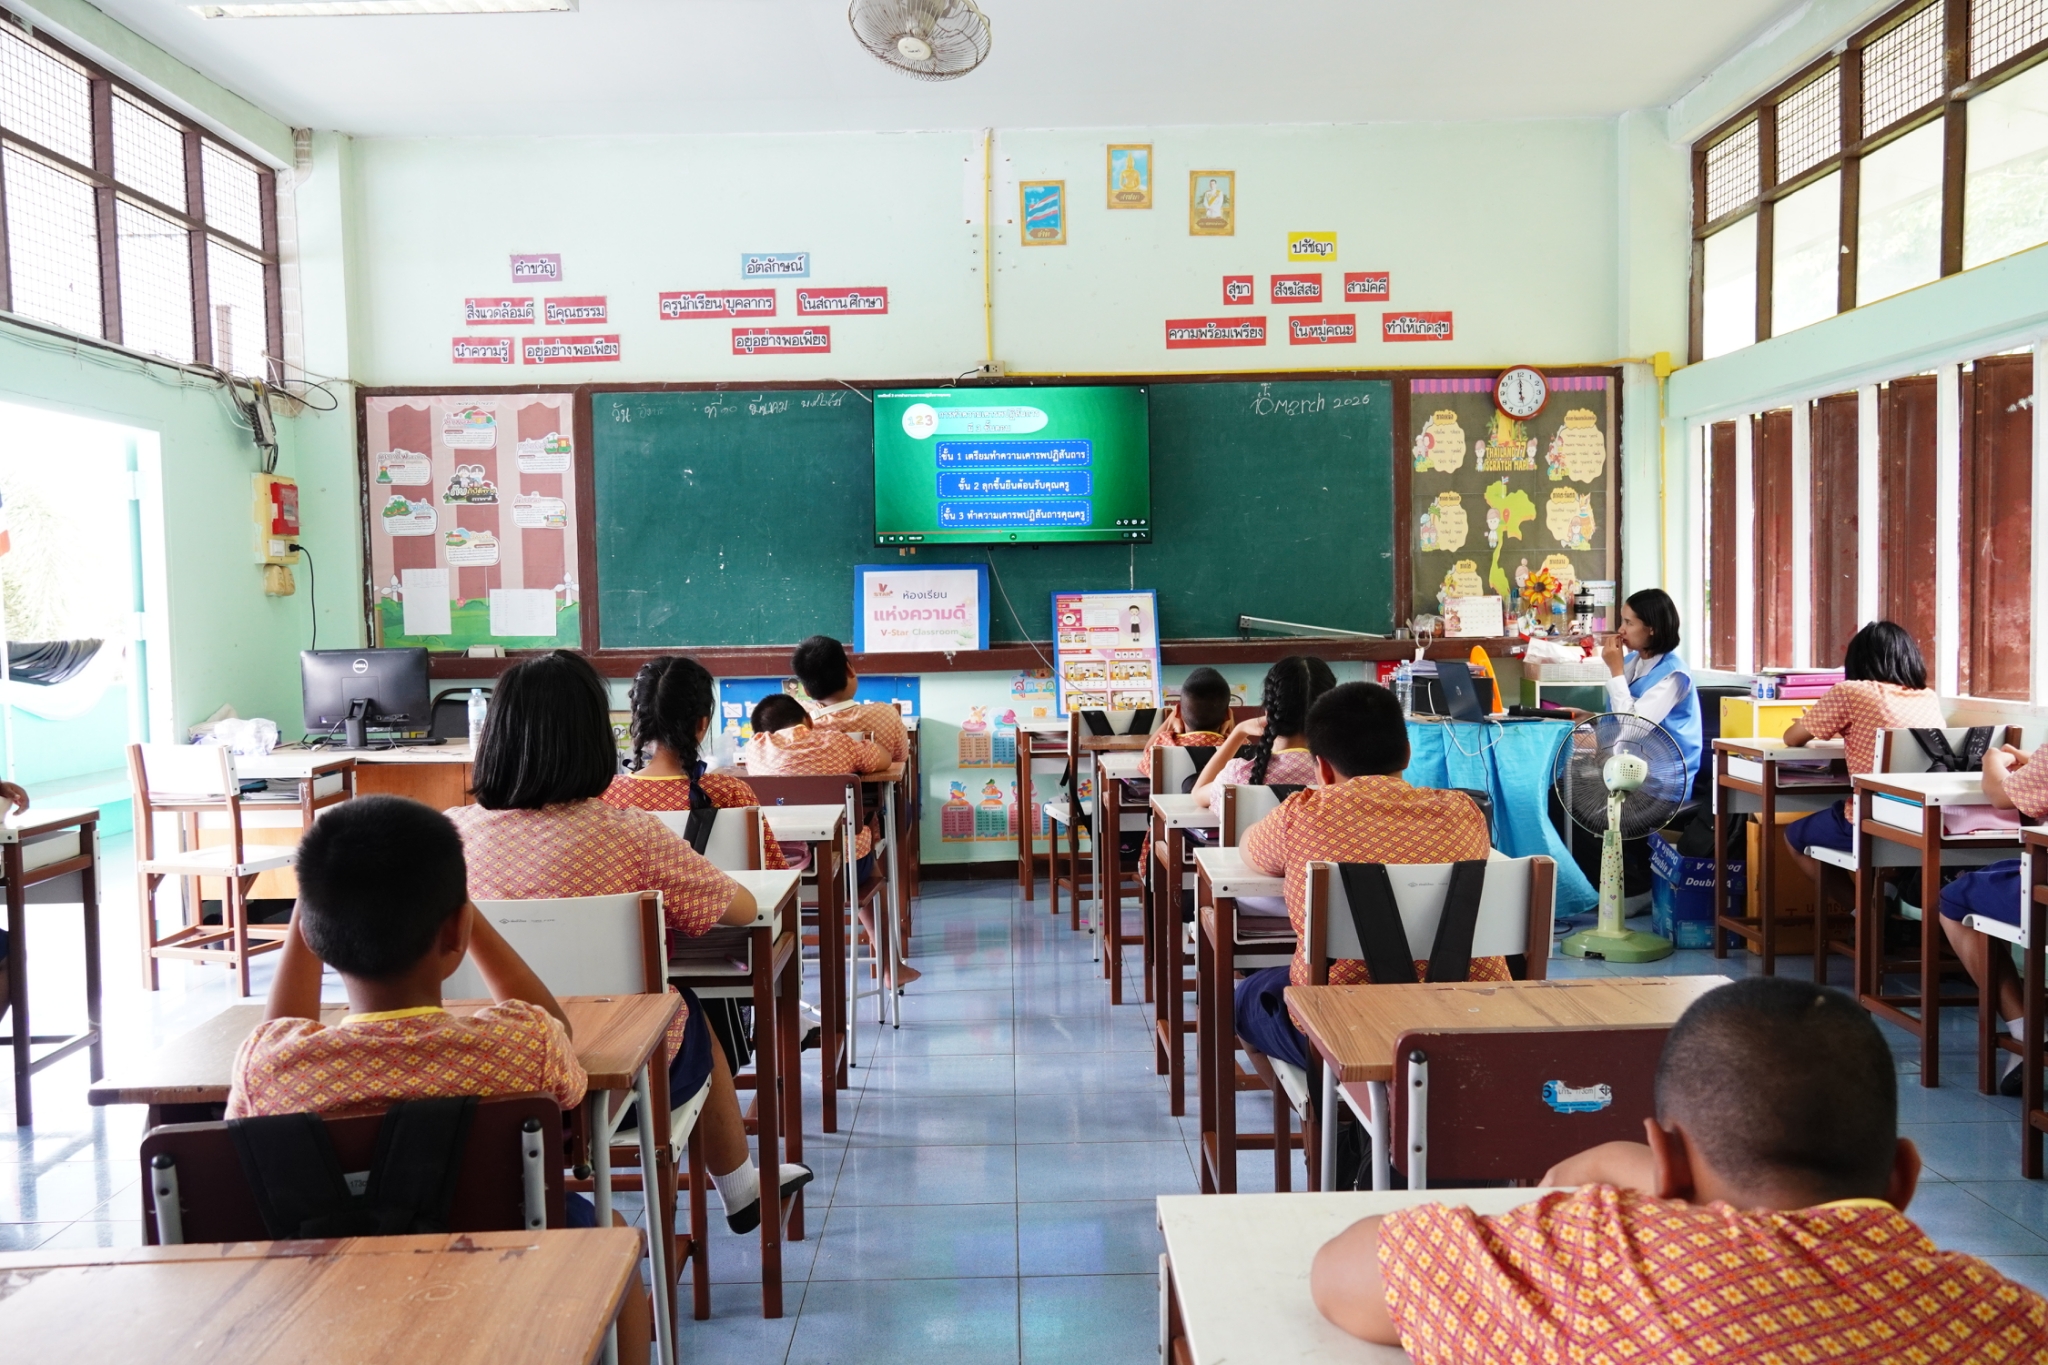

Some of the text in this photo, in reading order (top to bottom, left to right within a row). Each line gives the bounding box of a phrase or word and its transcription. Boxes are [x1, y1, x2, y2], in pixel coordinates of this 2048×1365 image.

[1292, 239, 1334, 256] ปรัชญา
[515, 260, 556, 278] คำขวัญ
[746, 255, 804, 274] อัตลักษณ์
[1228, 282, 1250, 300] สุขา
[1347, 279, 1387, 294] สามัคคี
[466, 301, 534, 320] สิ่งแวดล้อมดี
[547, 305, 604, 323] มีคุณธรรม
[1169, 323, 1263, 341] ความพร้อมเพรียง
[1386, 318, 1449, 339] ทำให้เกิดสุข
[526, 338, 618, 362] อยู่อย่างพอเพียง
[735, 330, 827, 353] อยู่อย่างพอเพียง
[455, 341, 509, 362] นำความรู้
[1333, 394, 1370, 408] 2026
[940, 448, 954, 461] ขั้น
[957, 453, 962, 461] 1
[958, 477, 970, 491] ขั้น
[973, 482, 980, 491] 2
[943, 507, 956, 521] ขั้น
[958, 512, 964, 521] 3
[902, 590, 948, 600] ห้องเรียน
[873, 603, 966, 622] แห่งความดี
[880, 627, 959, 637] V-Star Classroom
[1651, 852, 1668, 873] Double
